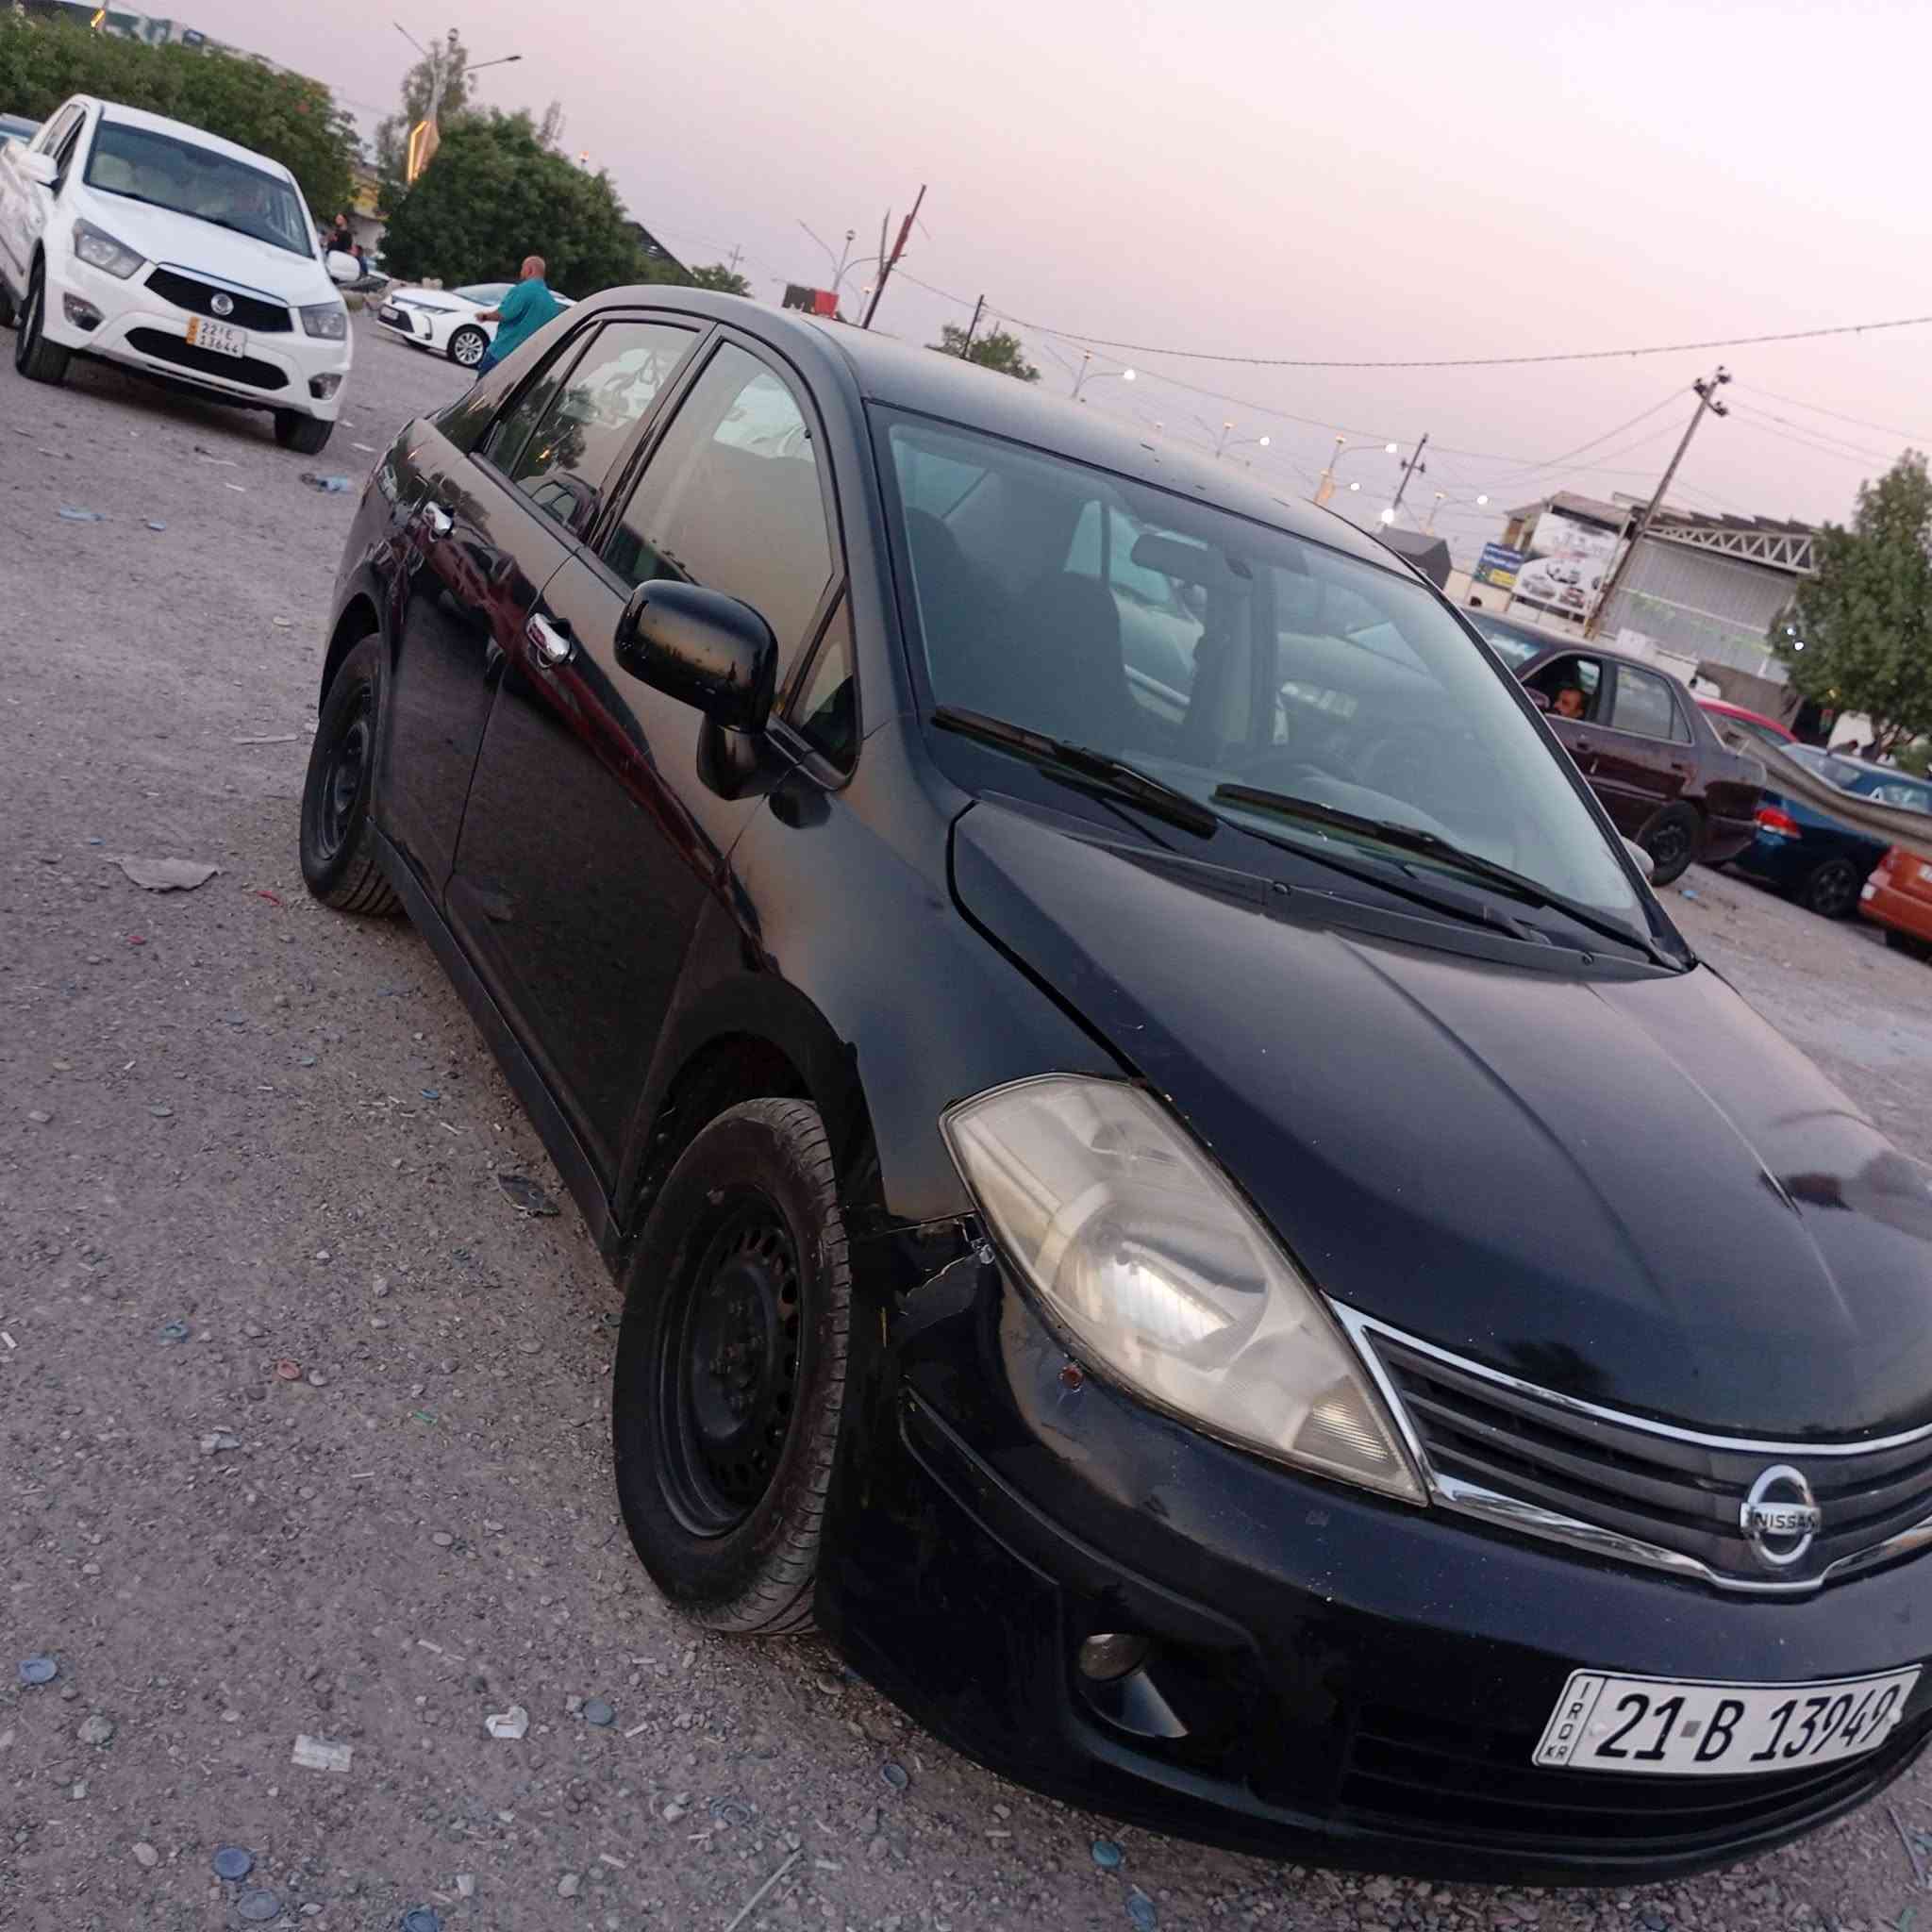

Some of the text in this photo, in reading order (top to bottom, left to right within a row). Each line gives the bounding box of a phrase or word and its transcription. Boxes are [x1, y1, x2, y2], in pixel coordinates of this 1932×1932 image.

[202, 323, 218, 335] 22
[1752, 1511, 1816, 1529] NISSAN
[1594, 1684, 1902, 1762] 21 B 13949
